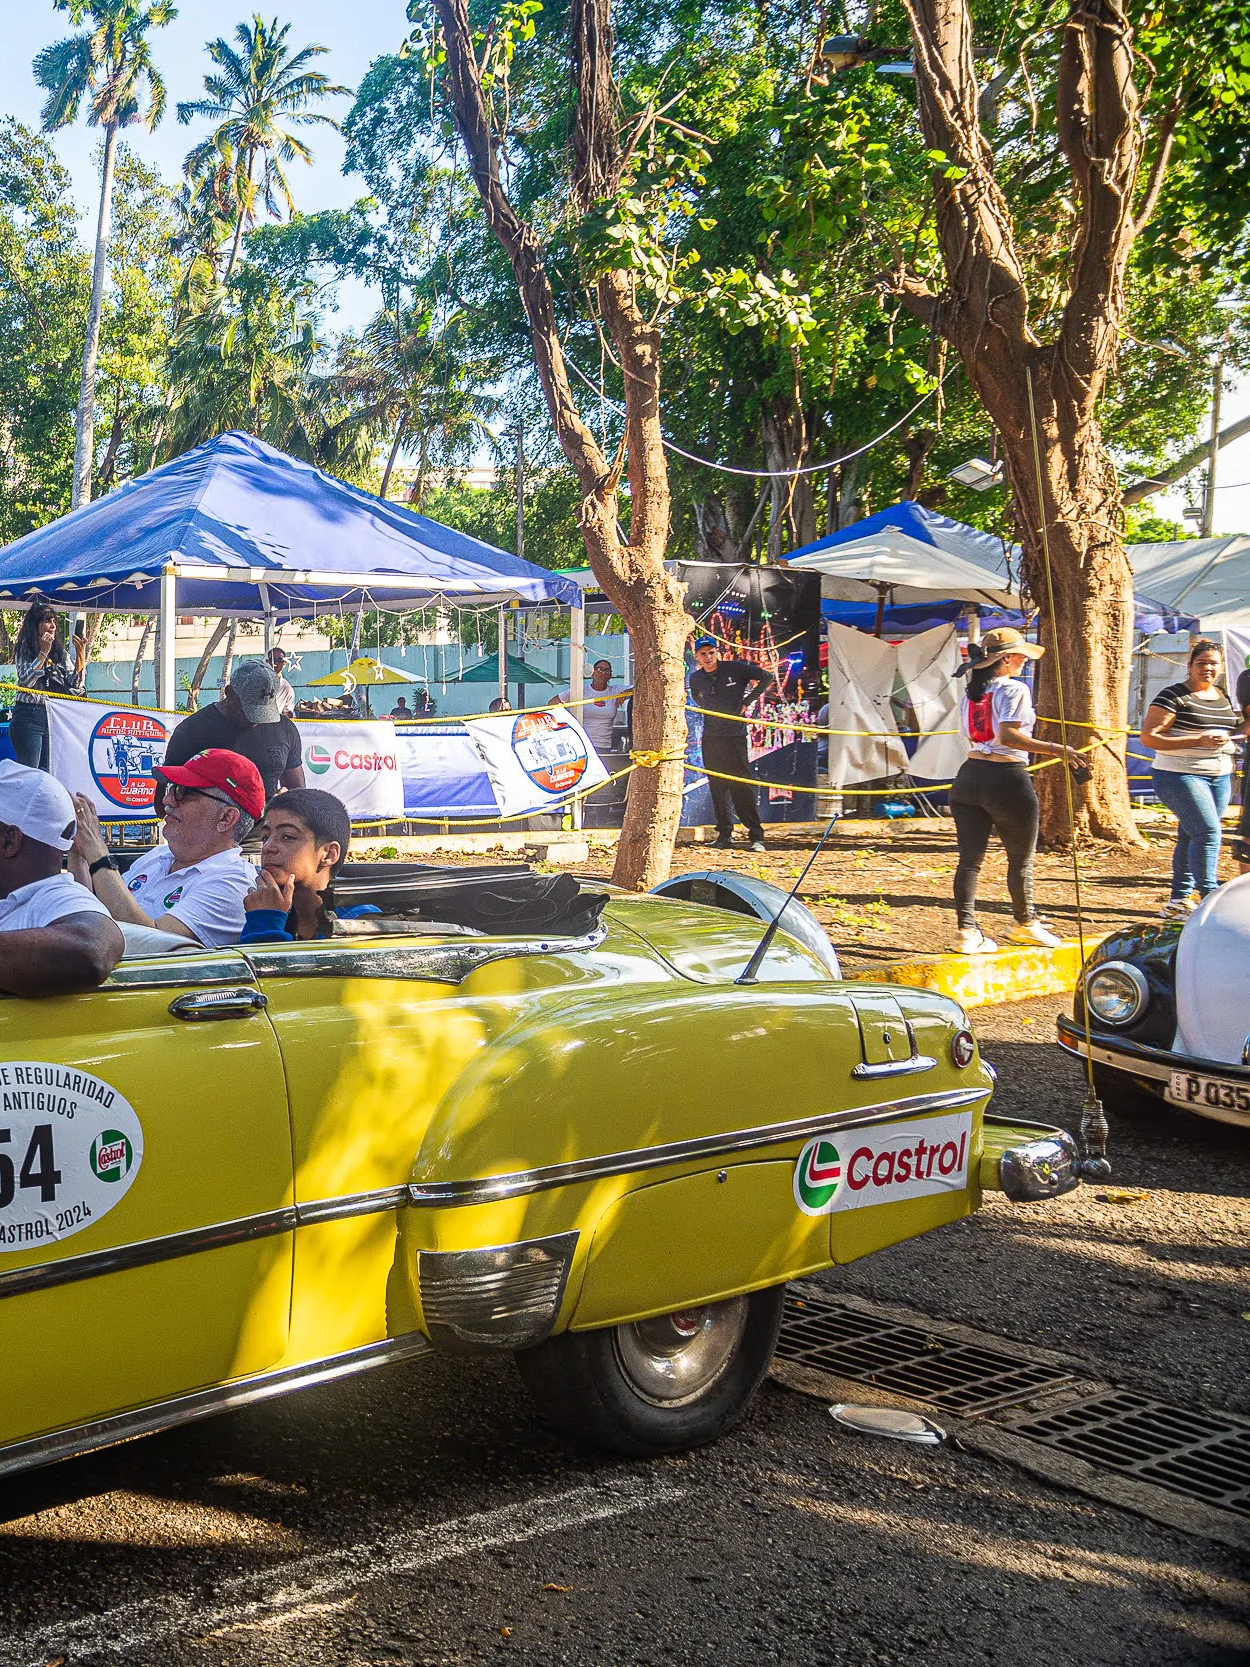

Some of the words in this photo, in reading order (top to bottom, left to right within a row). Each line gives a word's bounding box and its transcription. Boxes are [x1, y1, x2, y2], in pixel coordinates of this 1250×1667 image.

[334, 750, 397, 771] Castrol
[120, 787, 155, 795] CUBANO
[15, 1066, 115, 1109] REGULARIDAD
[3, 1091, 77, 1119] ANTIGUOS
[98, 1141, 126, 1170] Castrol
[846, 1130, 967, 1191] Castrol
[57, 1200, 92, 1233] 2024
